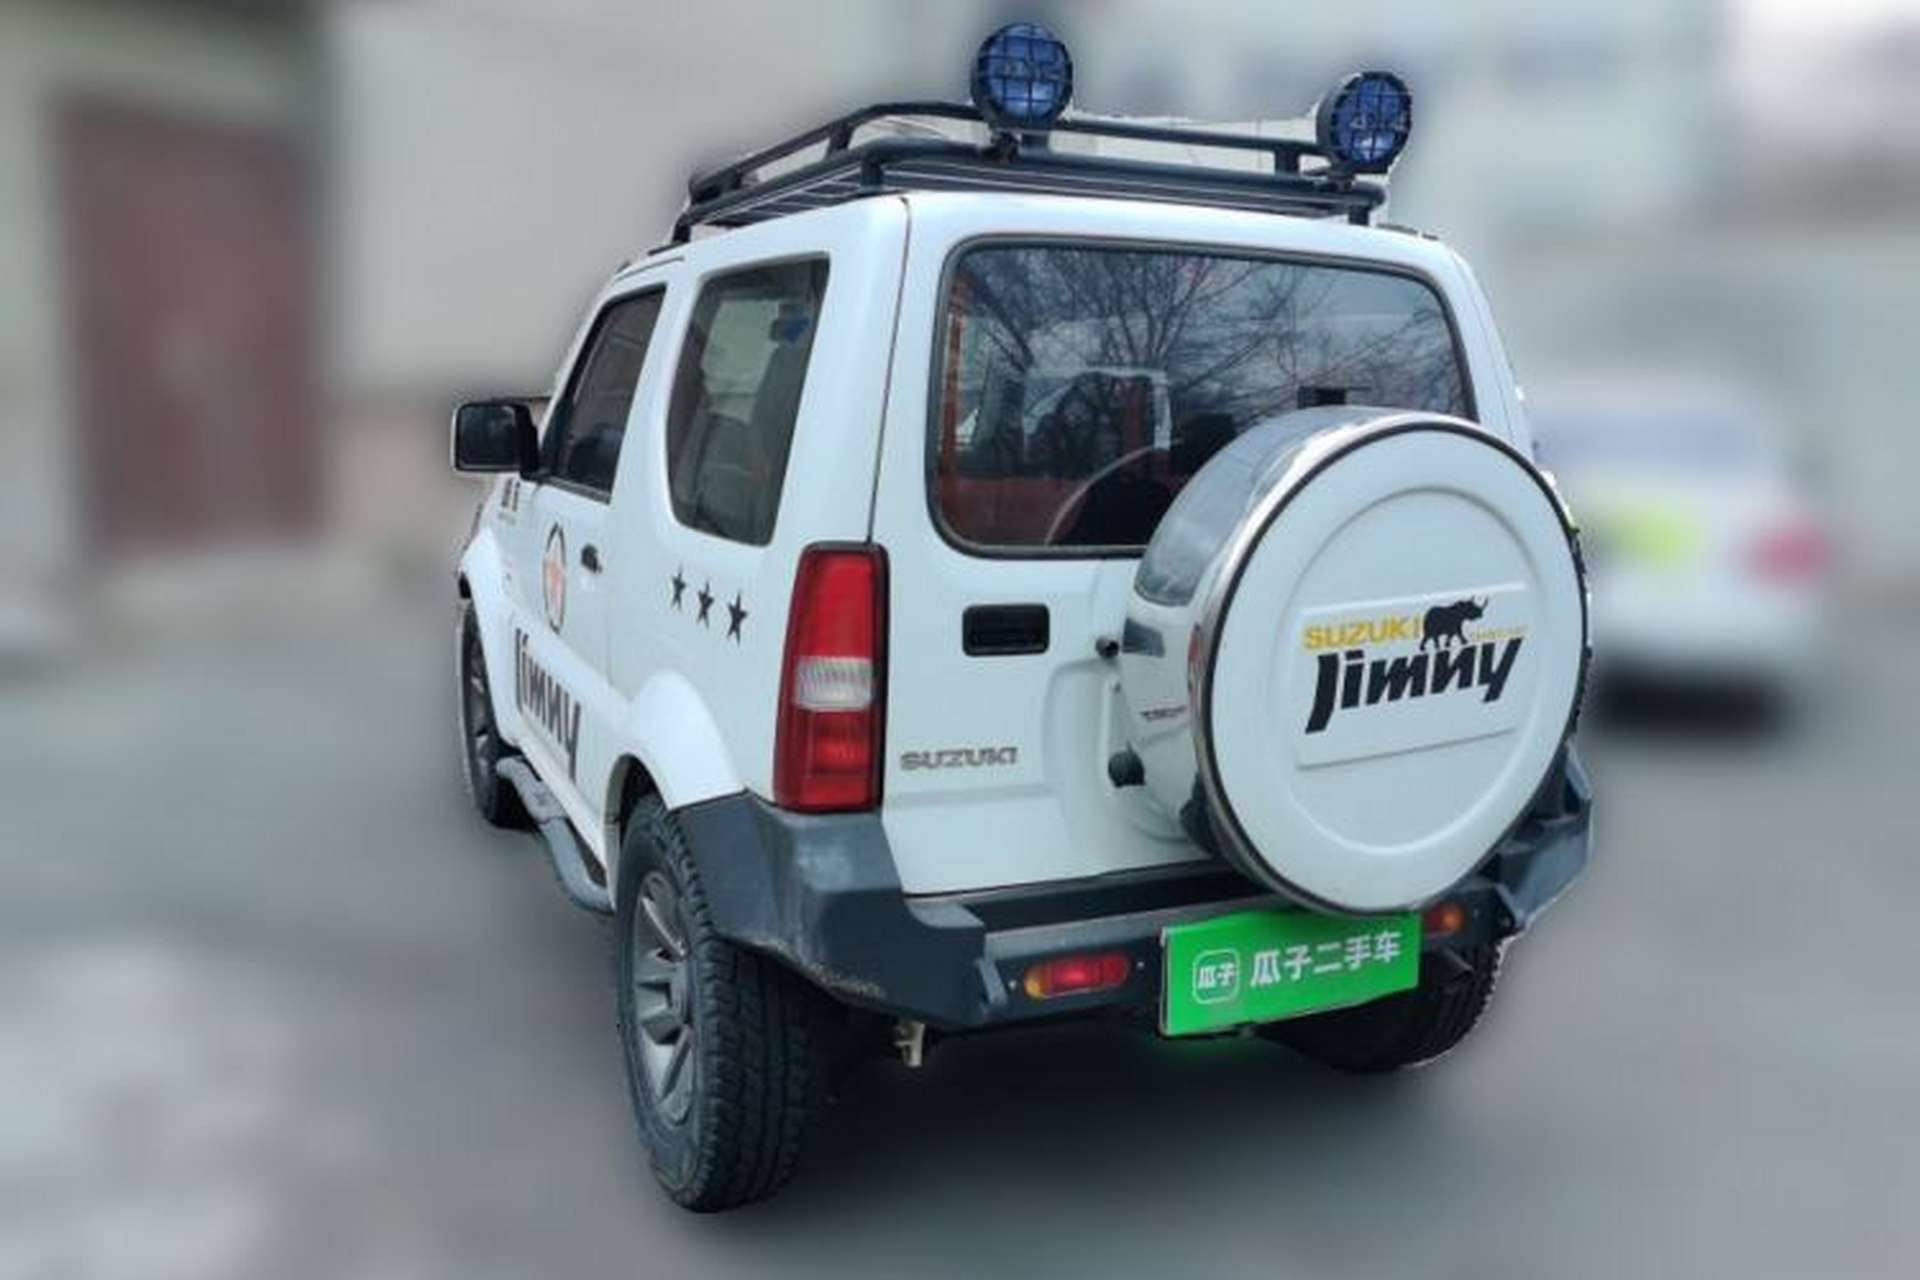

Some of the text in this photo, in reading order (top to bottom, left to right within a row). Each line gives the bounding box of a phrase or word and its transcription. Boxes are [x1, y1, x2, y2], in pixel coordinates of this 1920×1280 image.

[1303, 615, 1420, 648] SUZUKI
[515, 628, 580, 785] Jimny
[1305, 637, 1523, 734] Jimny
[900, 747, 1018, 770] SUZUKI
[1197, 962, 1236, 989] 瓜子
[1250, 930, 1402, 987] 瓜子二手车
